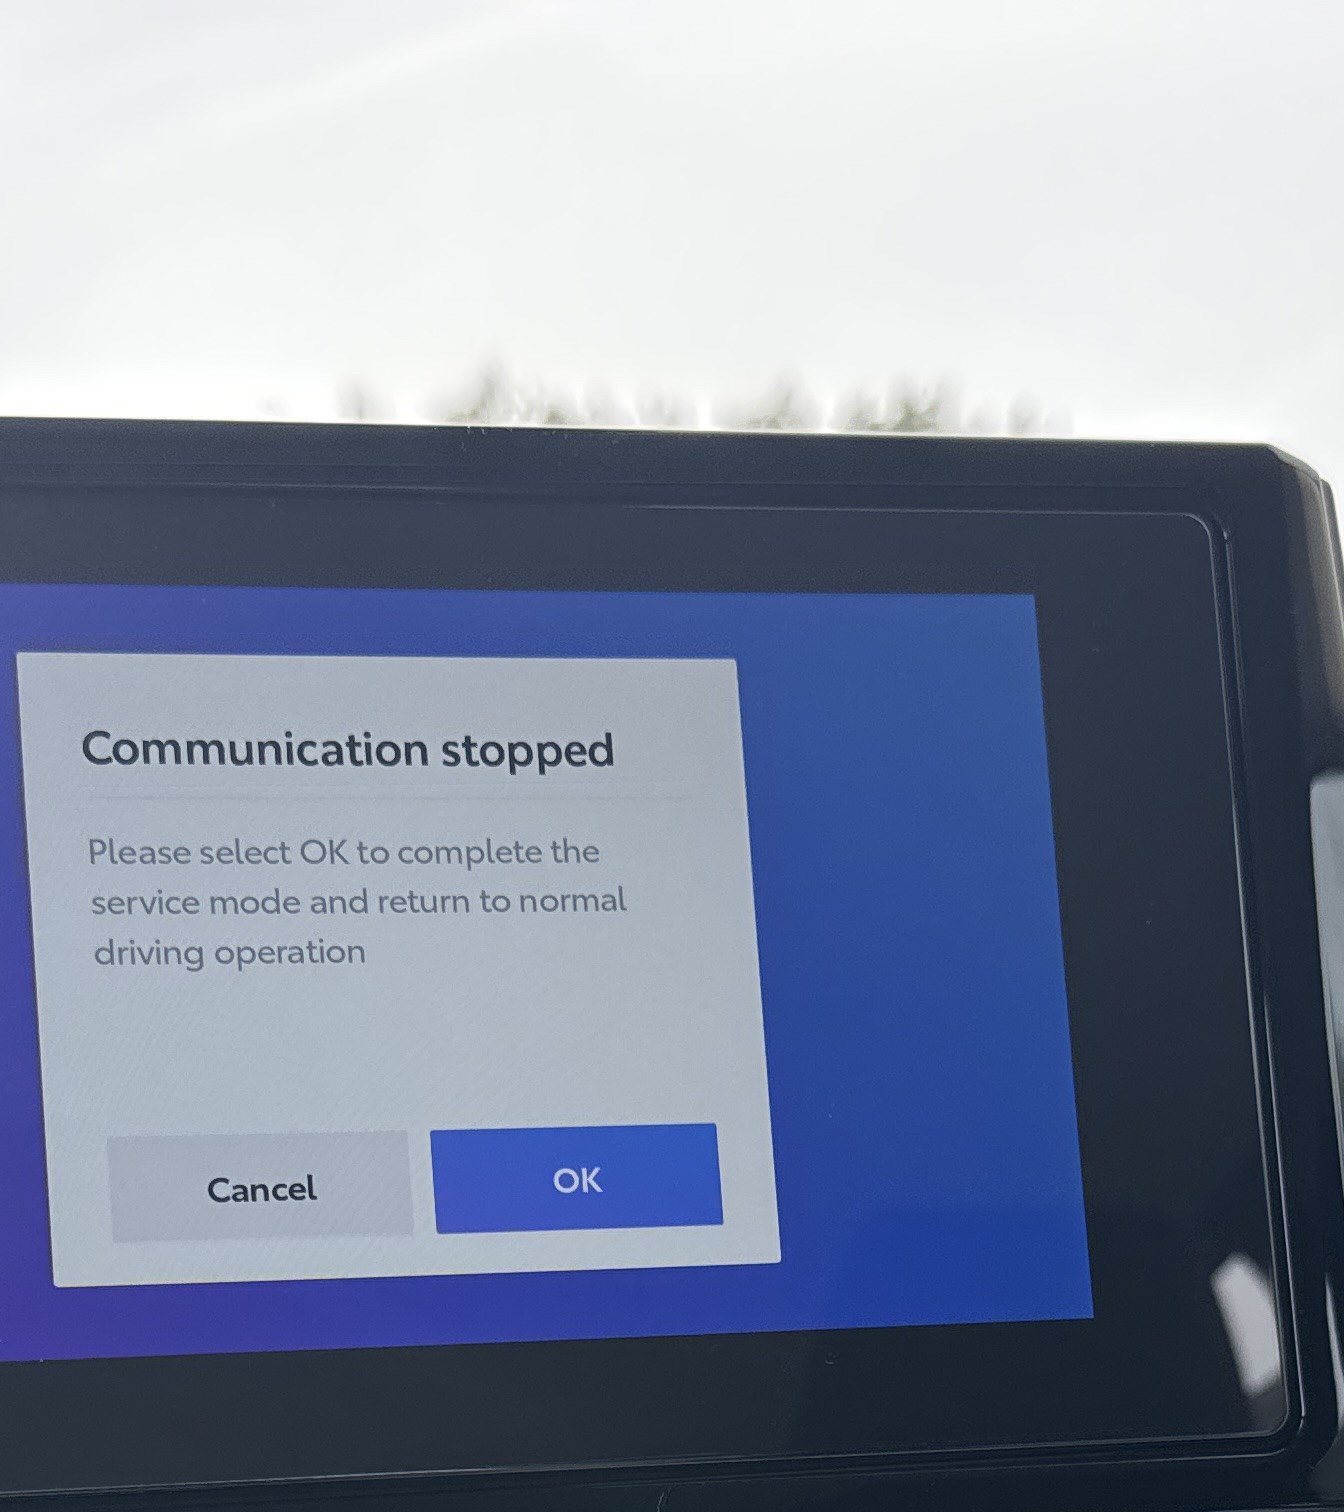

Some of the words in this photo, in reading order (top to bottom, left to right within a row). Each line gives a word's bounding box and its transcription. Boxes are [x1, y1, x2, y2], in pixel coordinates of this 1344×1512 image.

[81, 729, 429, 768] Communication
[441, 732, 615, 775] stopped
[88, 838, 192, 866] Please
[199, 838, 292, 866] select
[299, 839, 351, 866] OK
[357, 842, 390, 865] to
[397, 838, 543, 871] complete
[550, 837, 600, 864] the
[91, 890, 200, 916] service
[210, 887, 301, 915] mode
[309, 887, 369, 915] and
[378, 890, 470, 914] return
[479, 889, 511, 914] to
[520, 885, 627, 913] normal
[94, 938, 204, 972] driving
[214, 937, 367, 970] operation
[207, 1175, 318, 1204] Cancel
[553, 1167, 603, 1194] OK
